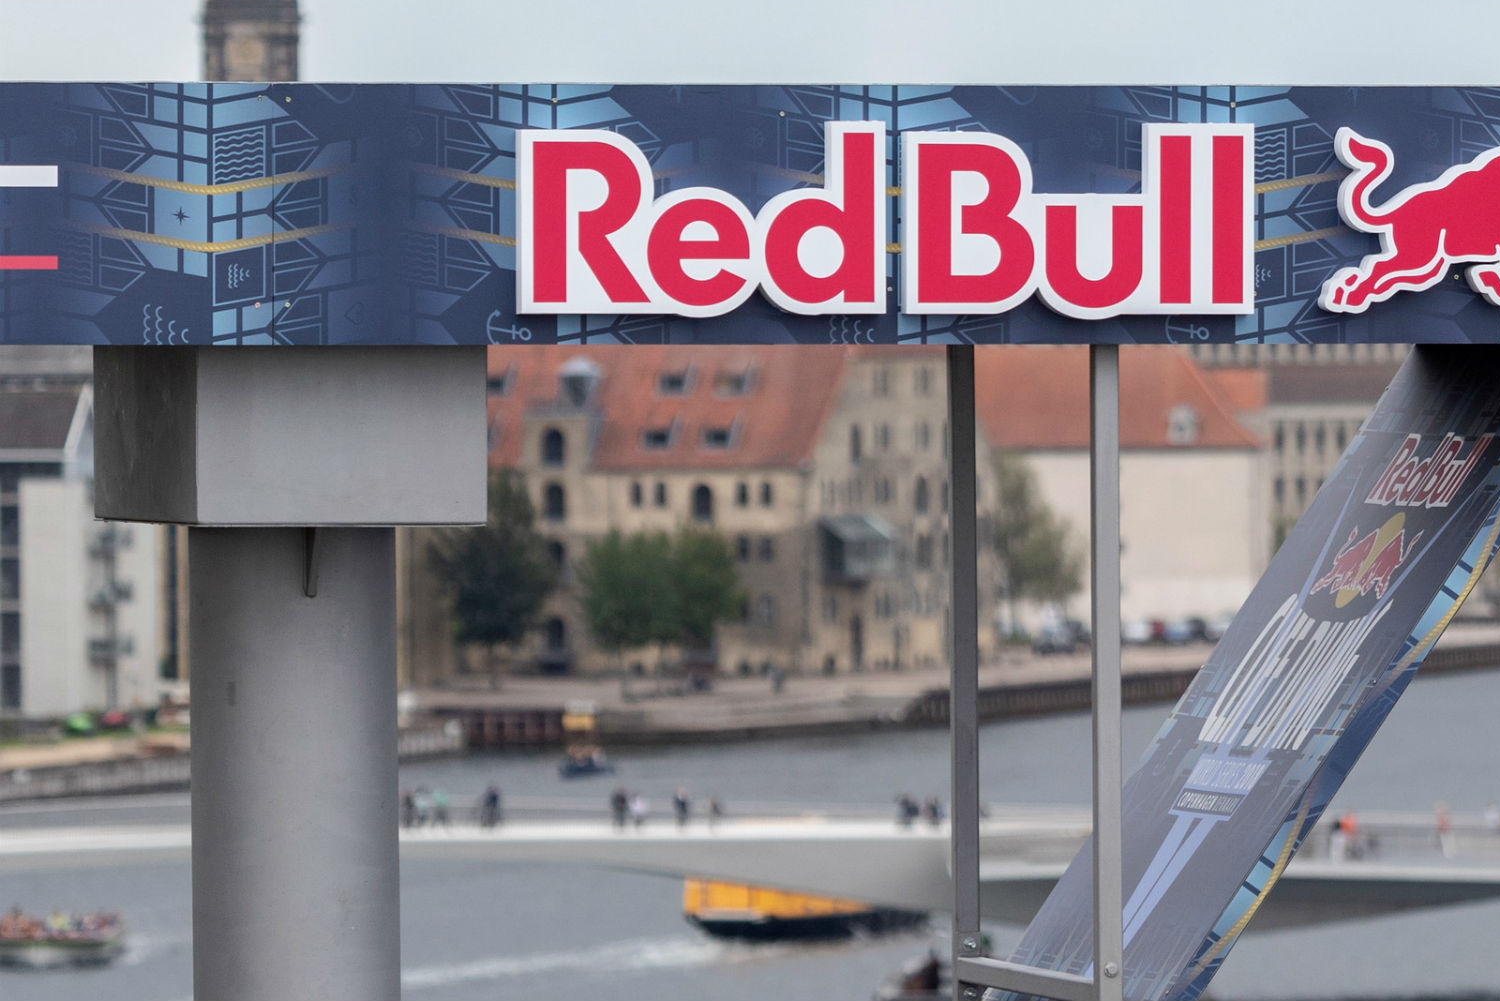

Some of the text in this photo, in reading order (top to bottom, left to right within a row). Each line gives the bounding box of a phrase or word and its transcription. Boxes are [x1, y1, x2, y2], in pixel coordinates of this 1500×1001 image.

[532, 131, 1244, 310] Red Bull
[1365, 432, 1495, 509] Red Bull
[1198, 593, 1393, 750] CLIFF DIVING
